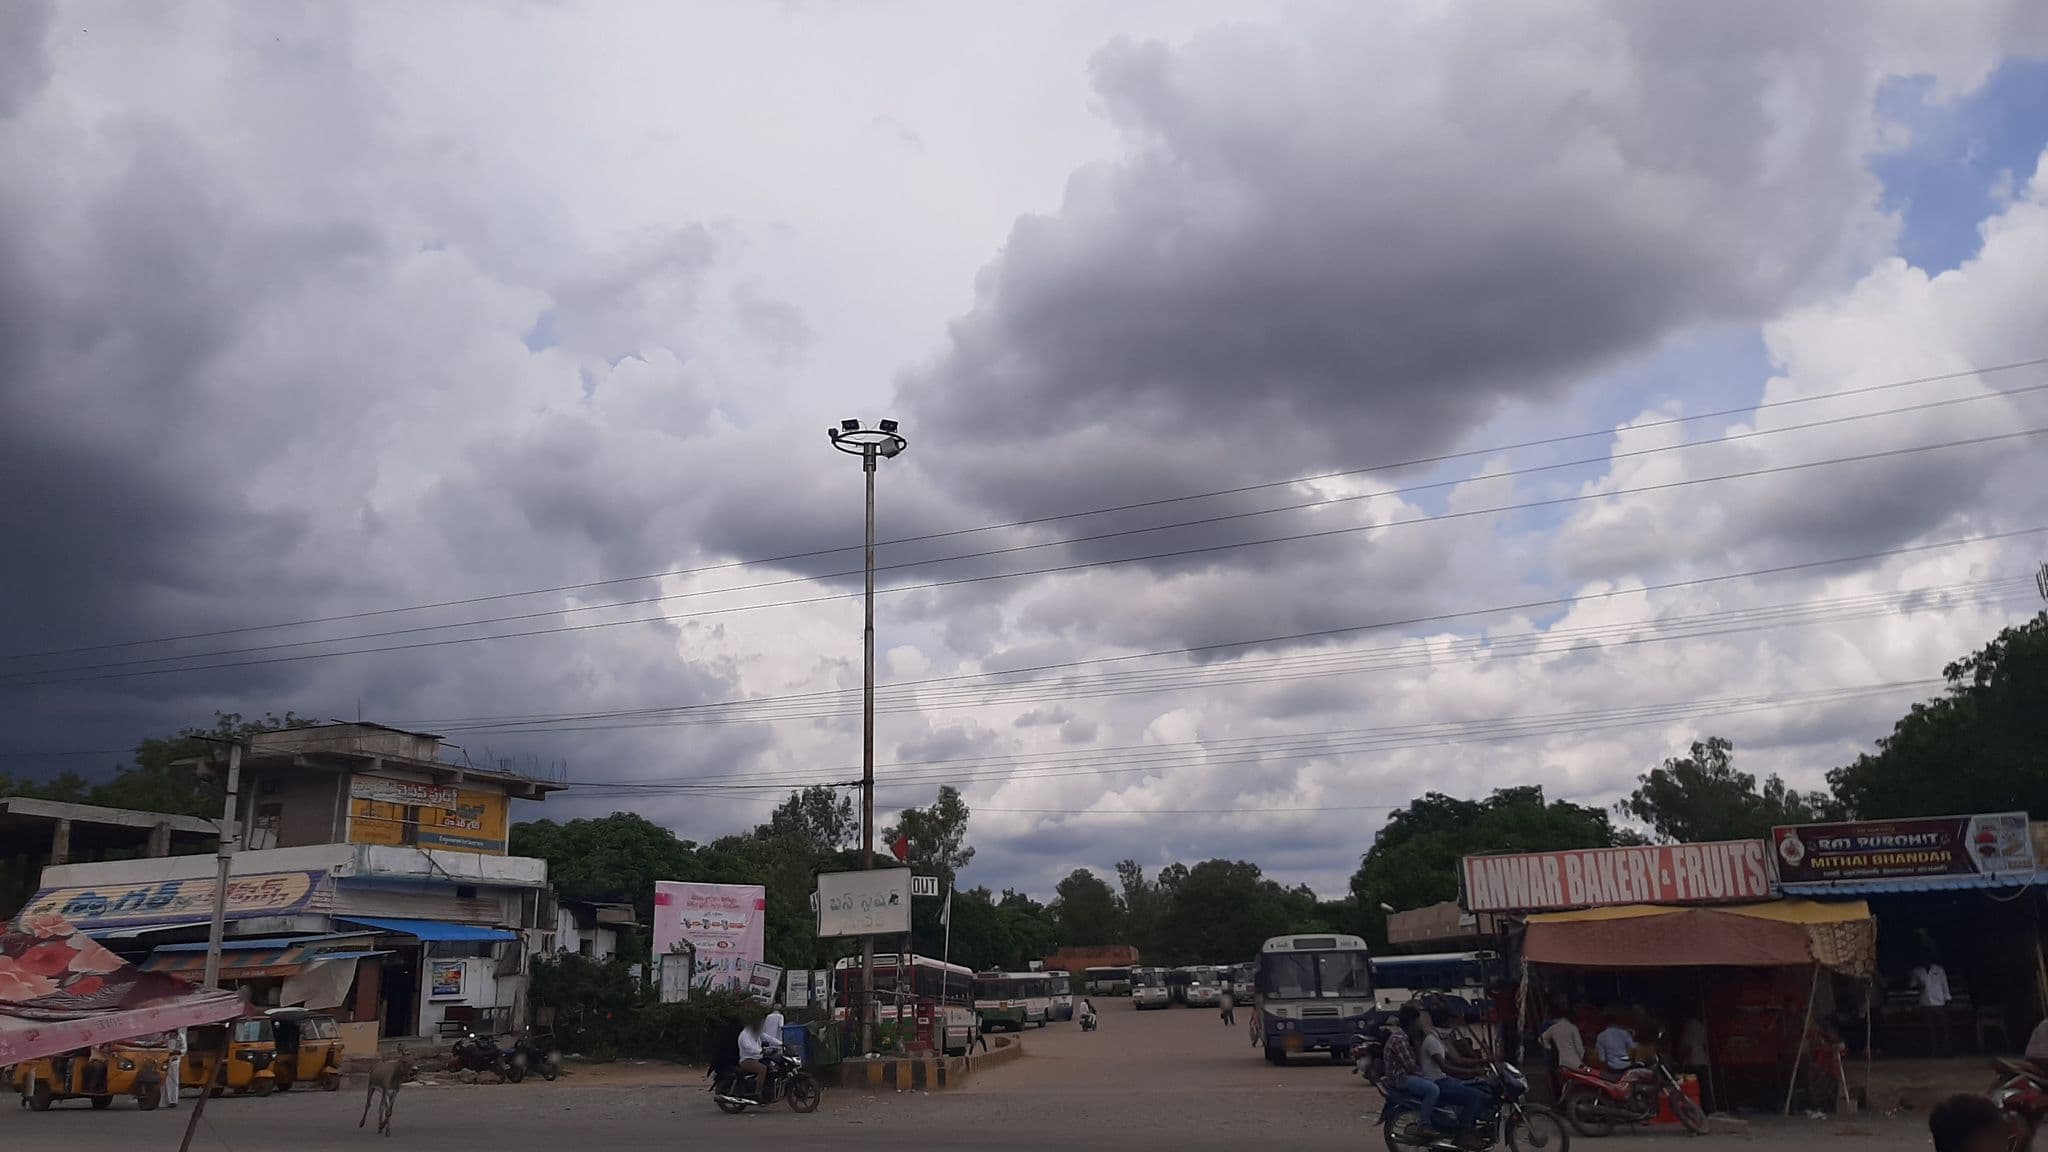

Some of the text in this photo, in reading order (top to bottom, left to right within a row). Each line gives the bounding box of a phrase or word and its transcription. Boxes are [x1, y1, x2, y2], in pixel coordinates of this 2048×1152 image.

[1856, 833, 1939, 848] PUROHIT
[1810, 850, 1953, 869] MITHAI BHANDAR
[1473, 843, 1766, 908] ANWAR BAKERY & FRUITS
[912, 877, 936, 895] OUT
